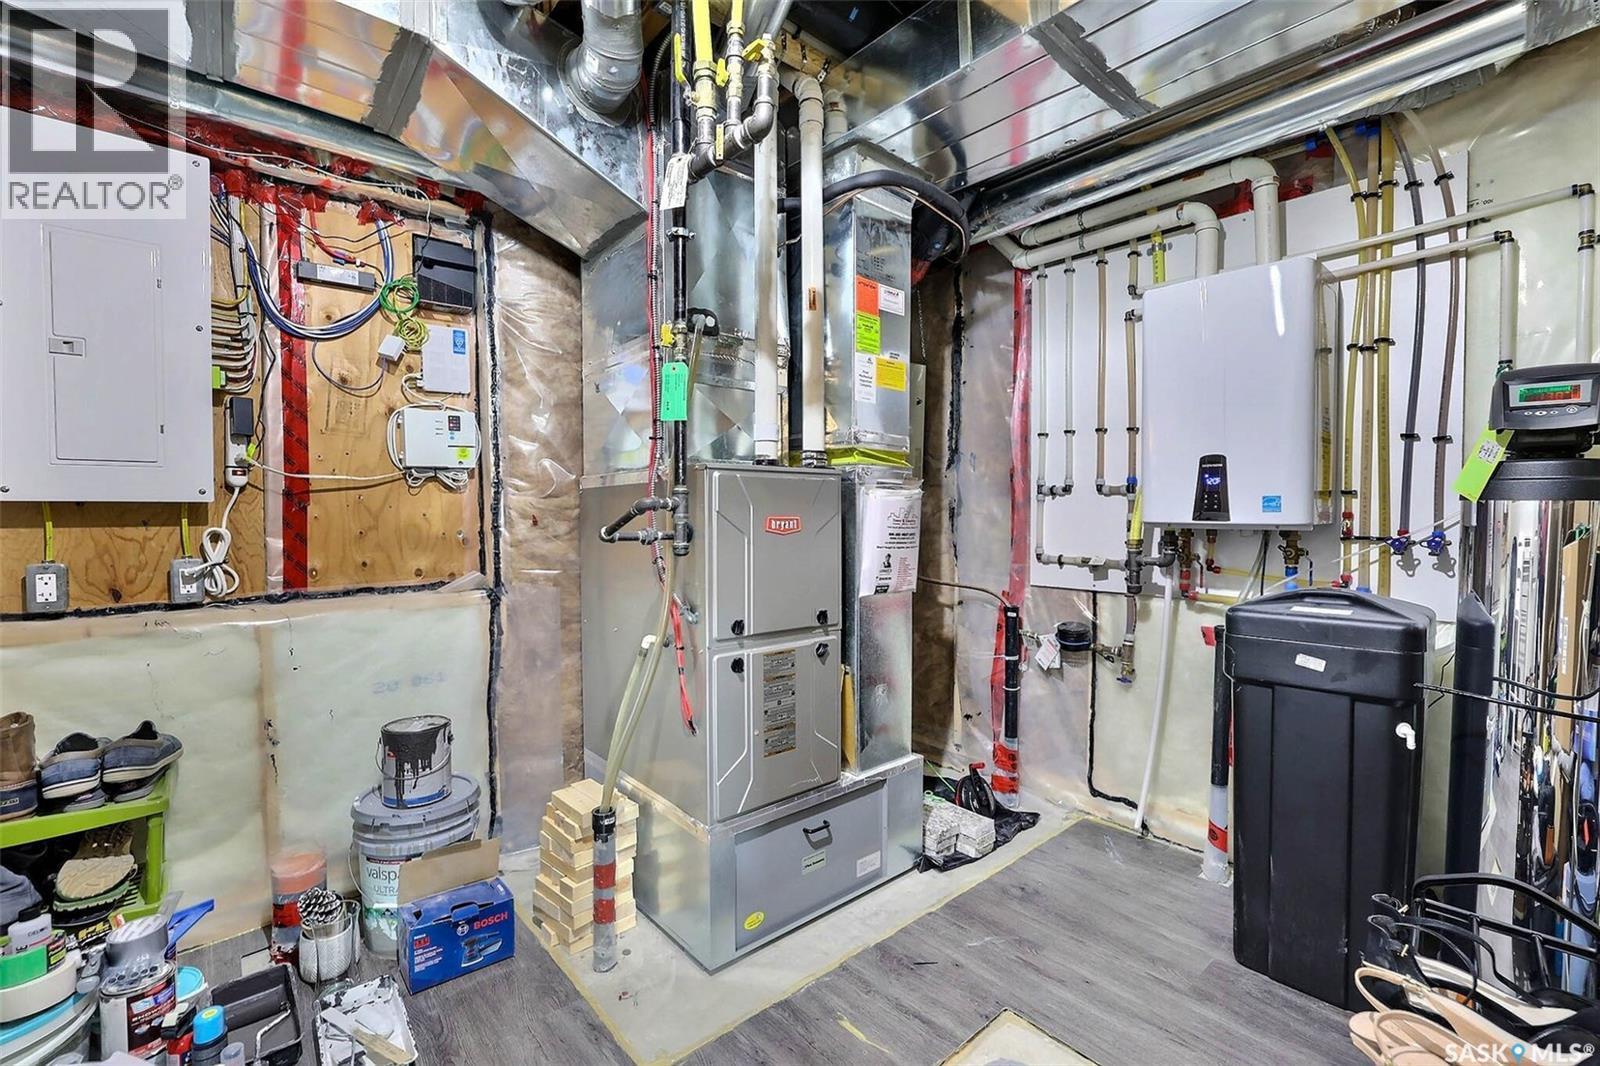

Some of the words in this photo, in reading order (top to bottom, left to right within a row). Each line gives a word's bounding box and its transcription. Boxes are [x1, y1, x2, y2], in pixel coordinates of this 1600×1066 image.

[771, 519, 798, 531] bryant
[366, 866, 399, 884] valsp
[473, 911, 509, 930] BOSCH
